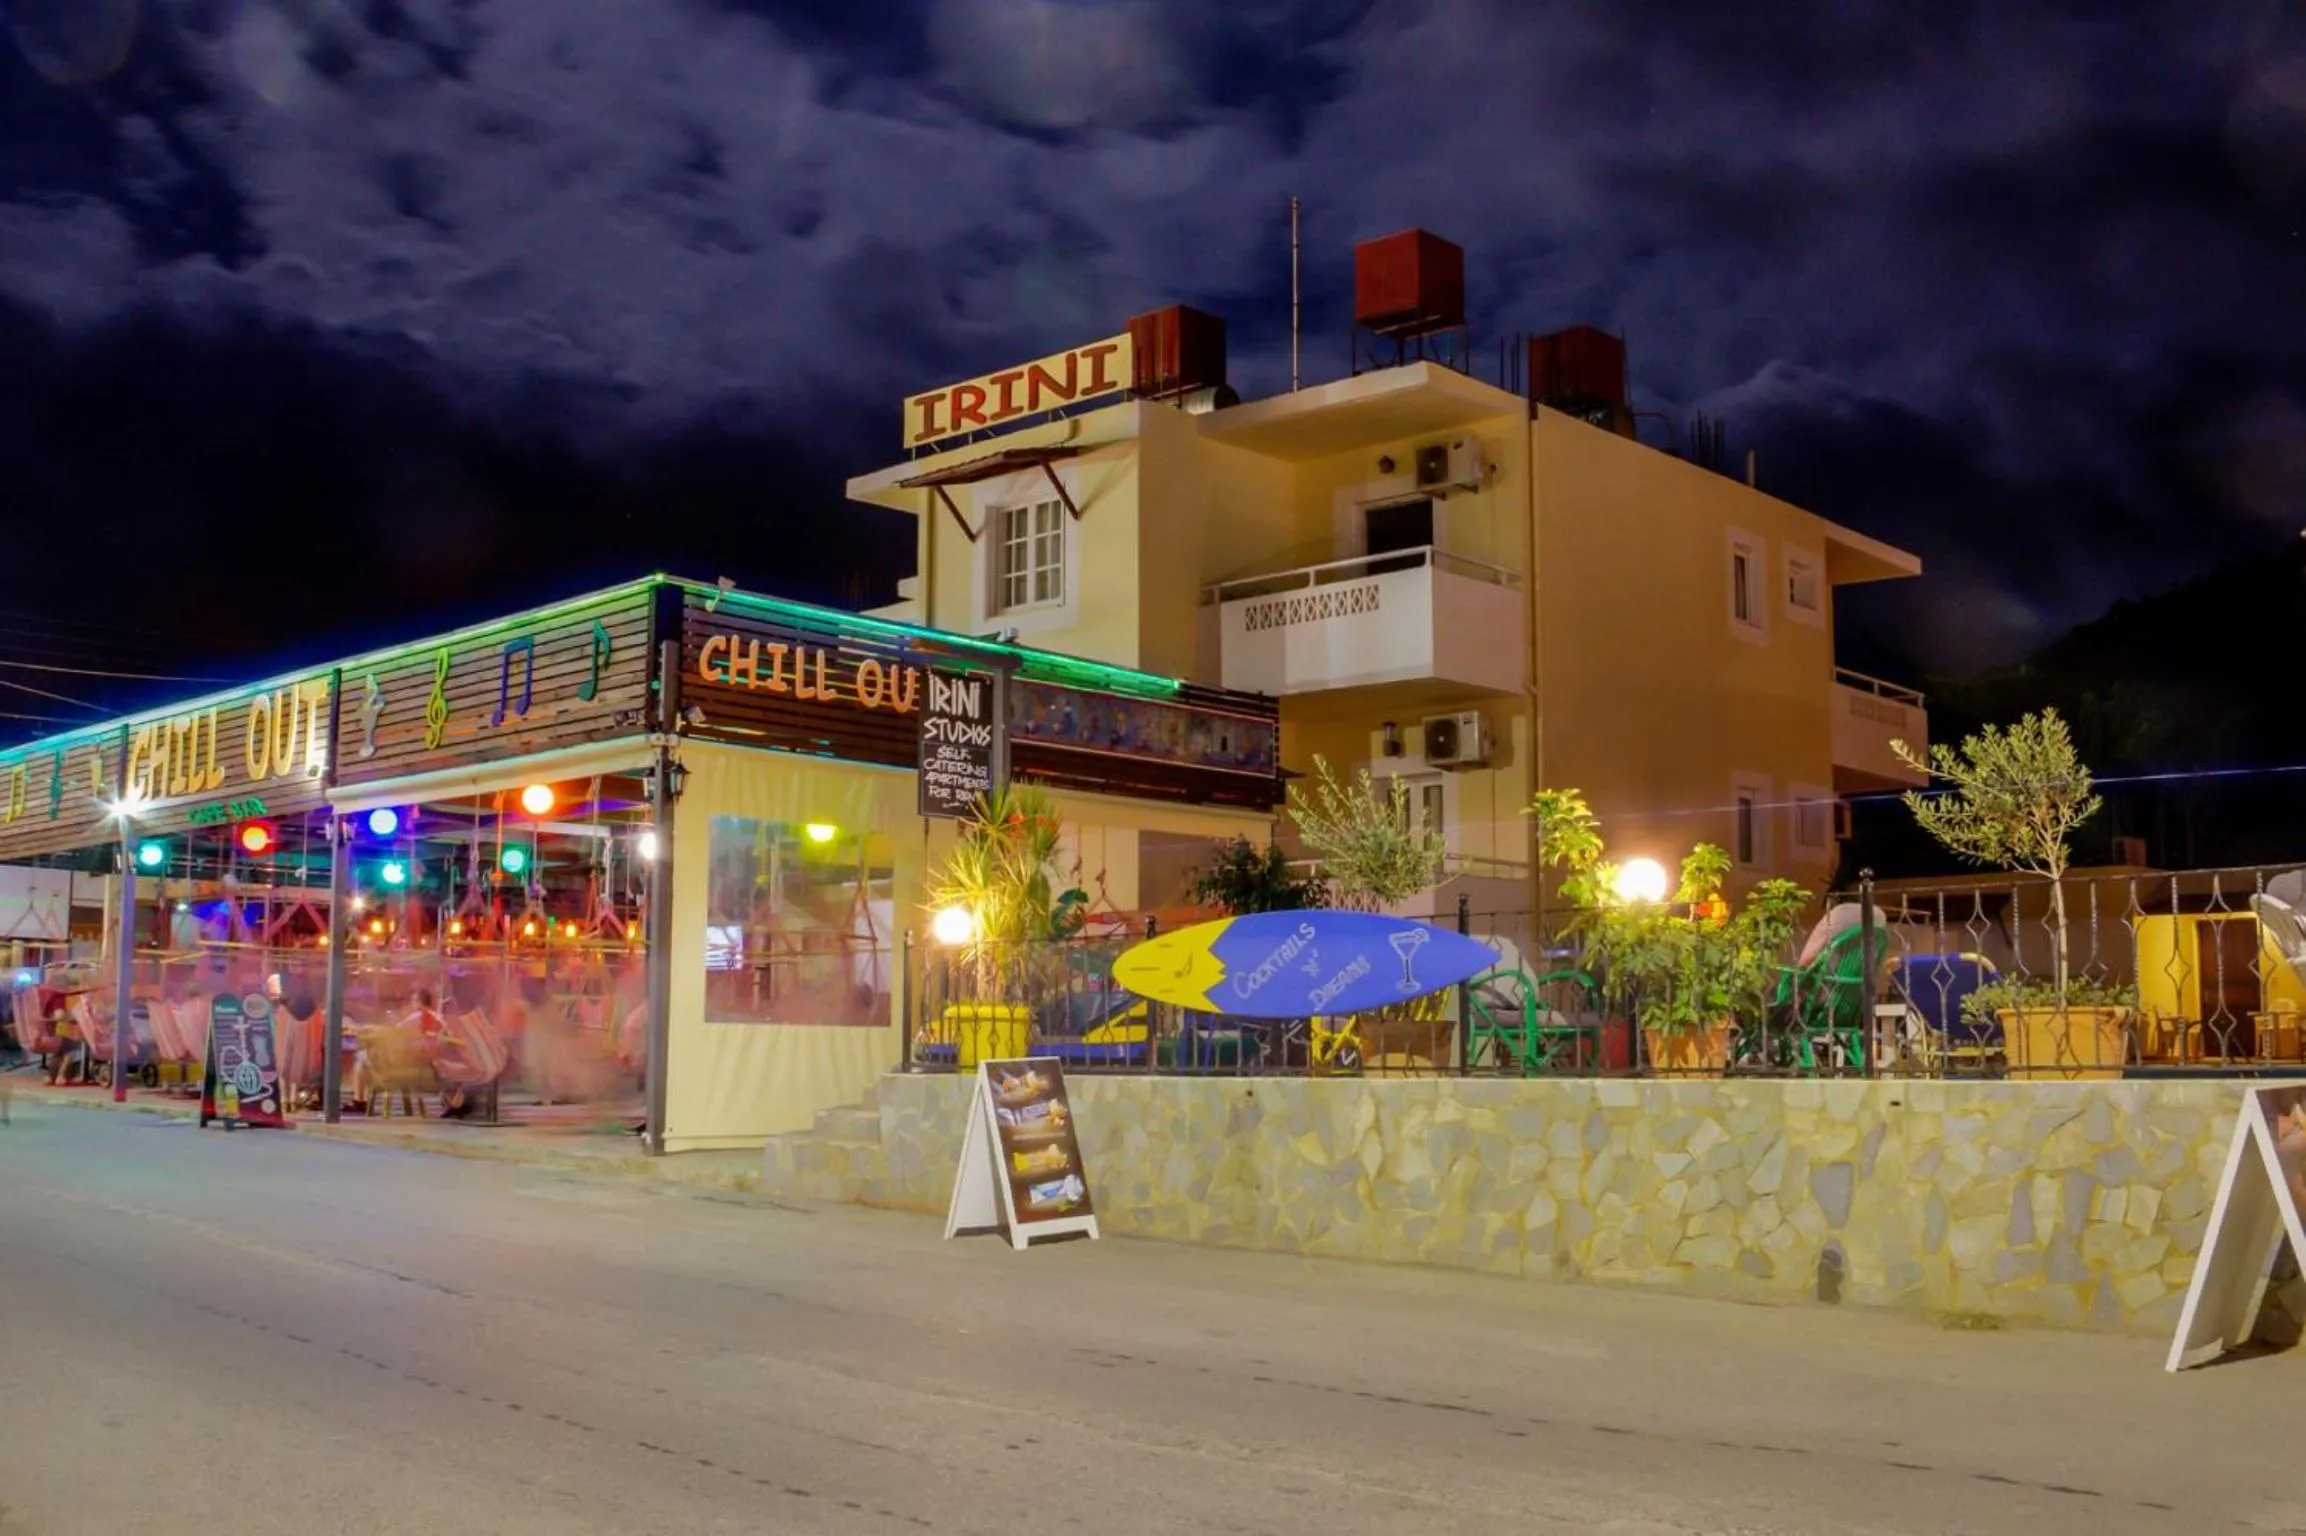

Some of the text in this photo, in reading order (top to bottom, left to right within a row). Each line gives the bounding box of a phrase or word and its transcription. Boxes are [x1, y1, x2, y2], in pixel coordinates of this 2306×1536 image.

[914, 344, 1118, 442] IRINI
[700, 634, 916, 713] CHILL OU
[928, 674, 981, 720] IRINI
[126, 680, 329, 800] CHILL OUT
[923, 716, 992, 747] STUDIOS
[923, 757, 988, 780] CATERING
[928, 785, 977, 802] FOR REN
